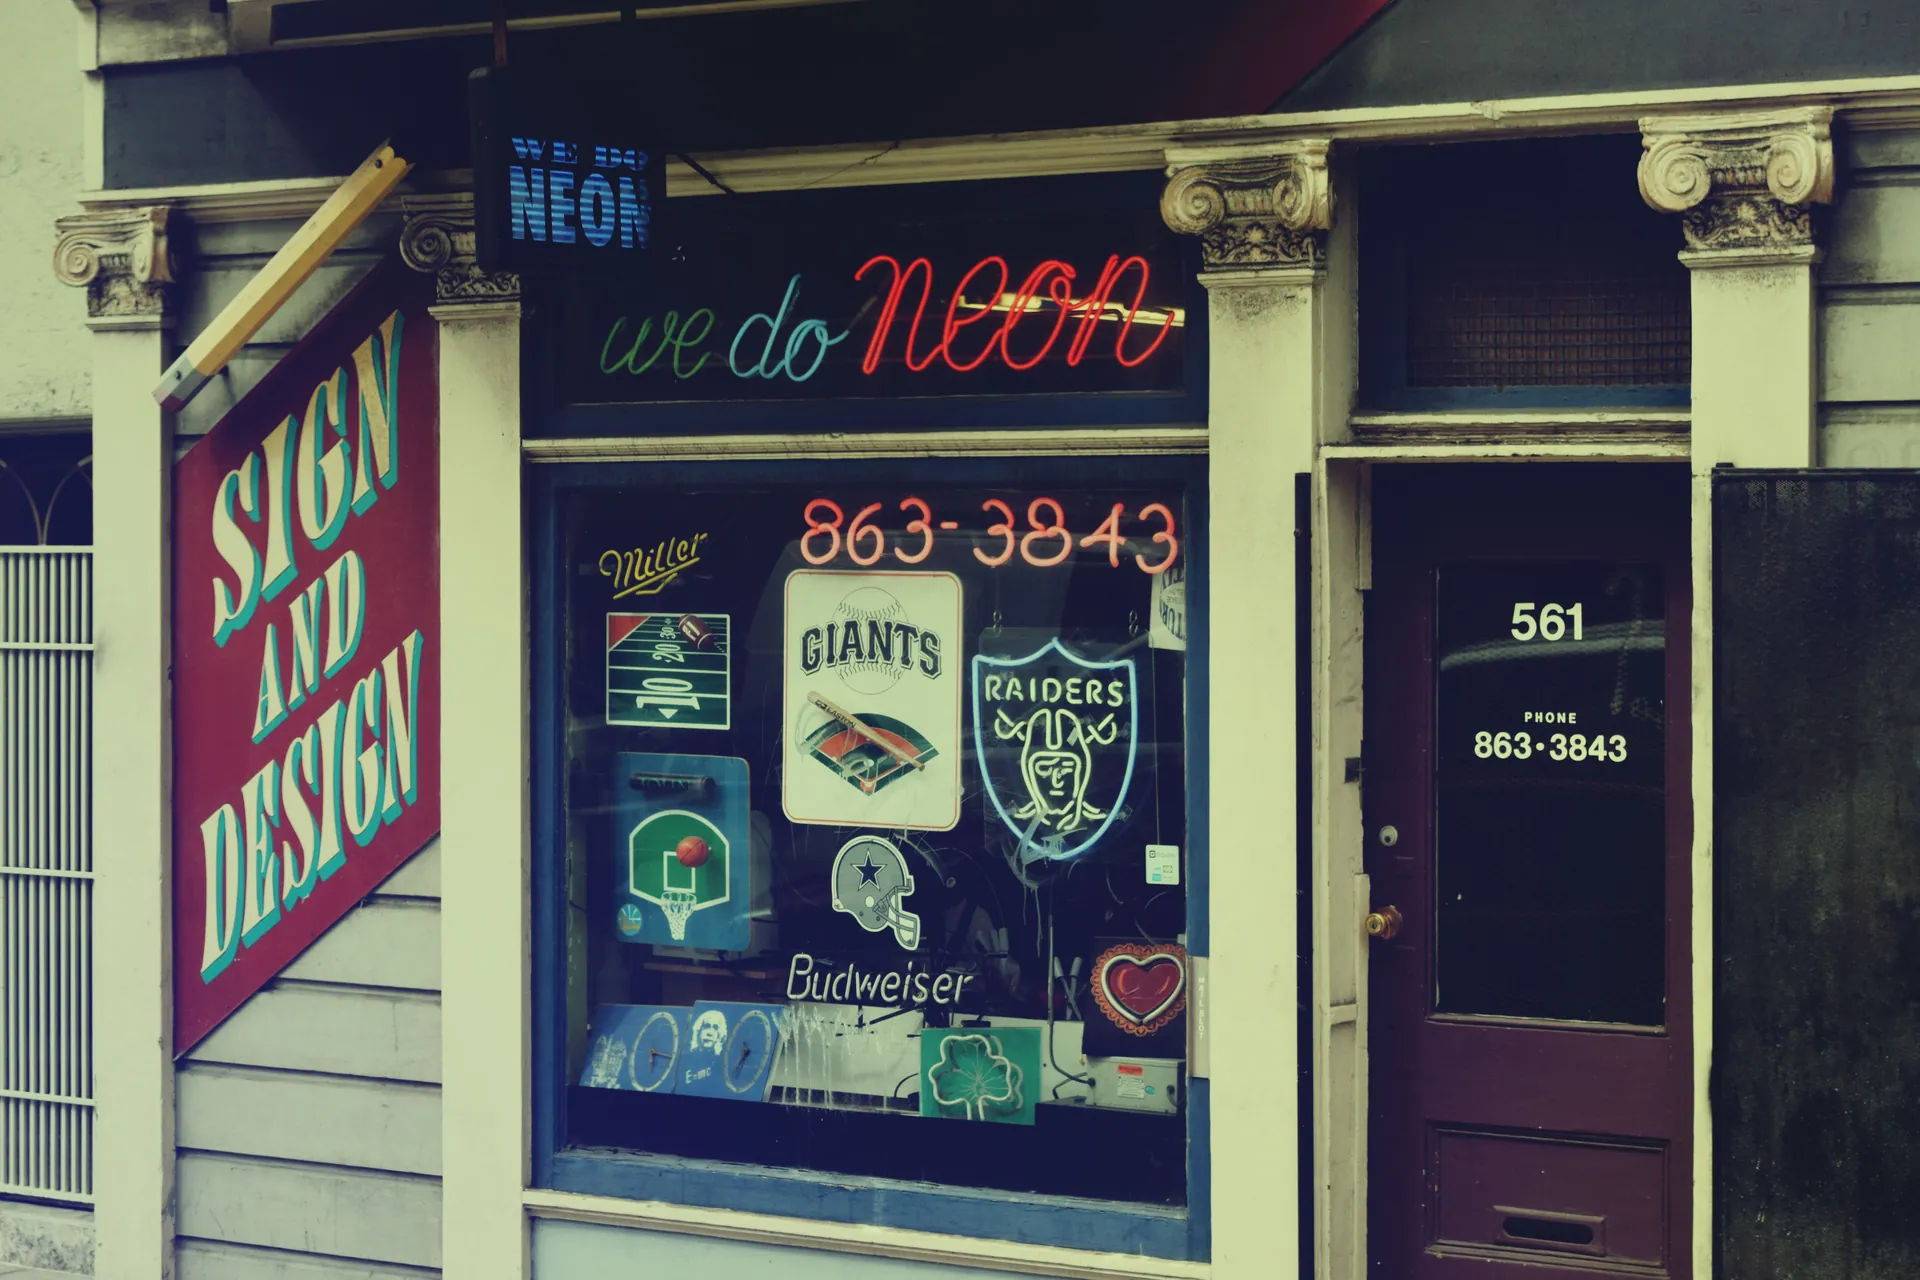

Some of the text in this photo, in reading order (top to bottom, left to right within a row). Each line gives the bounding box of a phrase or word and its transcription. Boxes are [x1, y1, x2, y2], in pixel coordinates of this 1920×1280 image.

[511, 136, 649, 172] WE DO
[509, 165, 651, 250] NEON
[600, 253, 1176, 382] we do neon
[212, 309, 406, 649] SIGN
[599, 532, 709, 589] Miller
[800, 496, 1179, 574] 863-3843
[251, 549, 366, 745] AND
[800, 617, 942, 680] GIANTS
[1510, 602, 1583, 642] 561
[652, 643, 685, 663] 20
[635, 677, 701, 710] 10
[826, 706, 857, 729] EASTON
[985, 674, 1124, 708] RAIDERS
[1524, 711, 1577, 725] PHONE
[200, 628, 424, 986] DESIGN
[786, 953, 974, 1004] Budweiser
